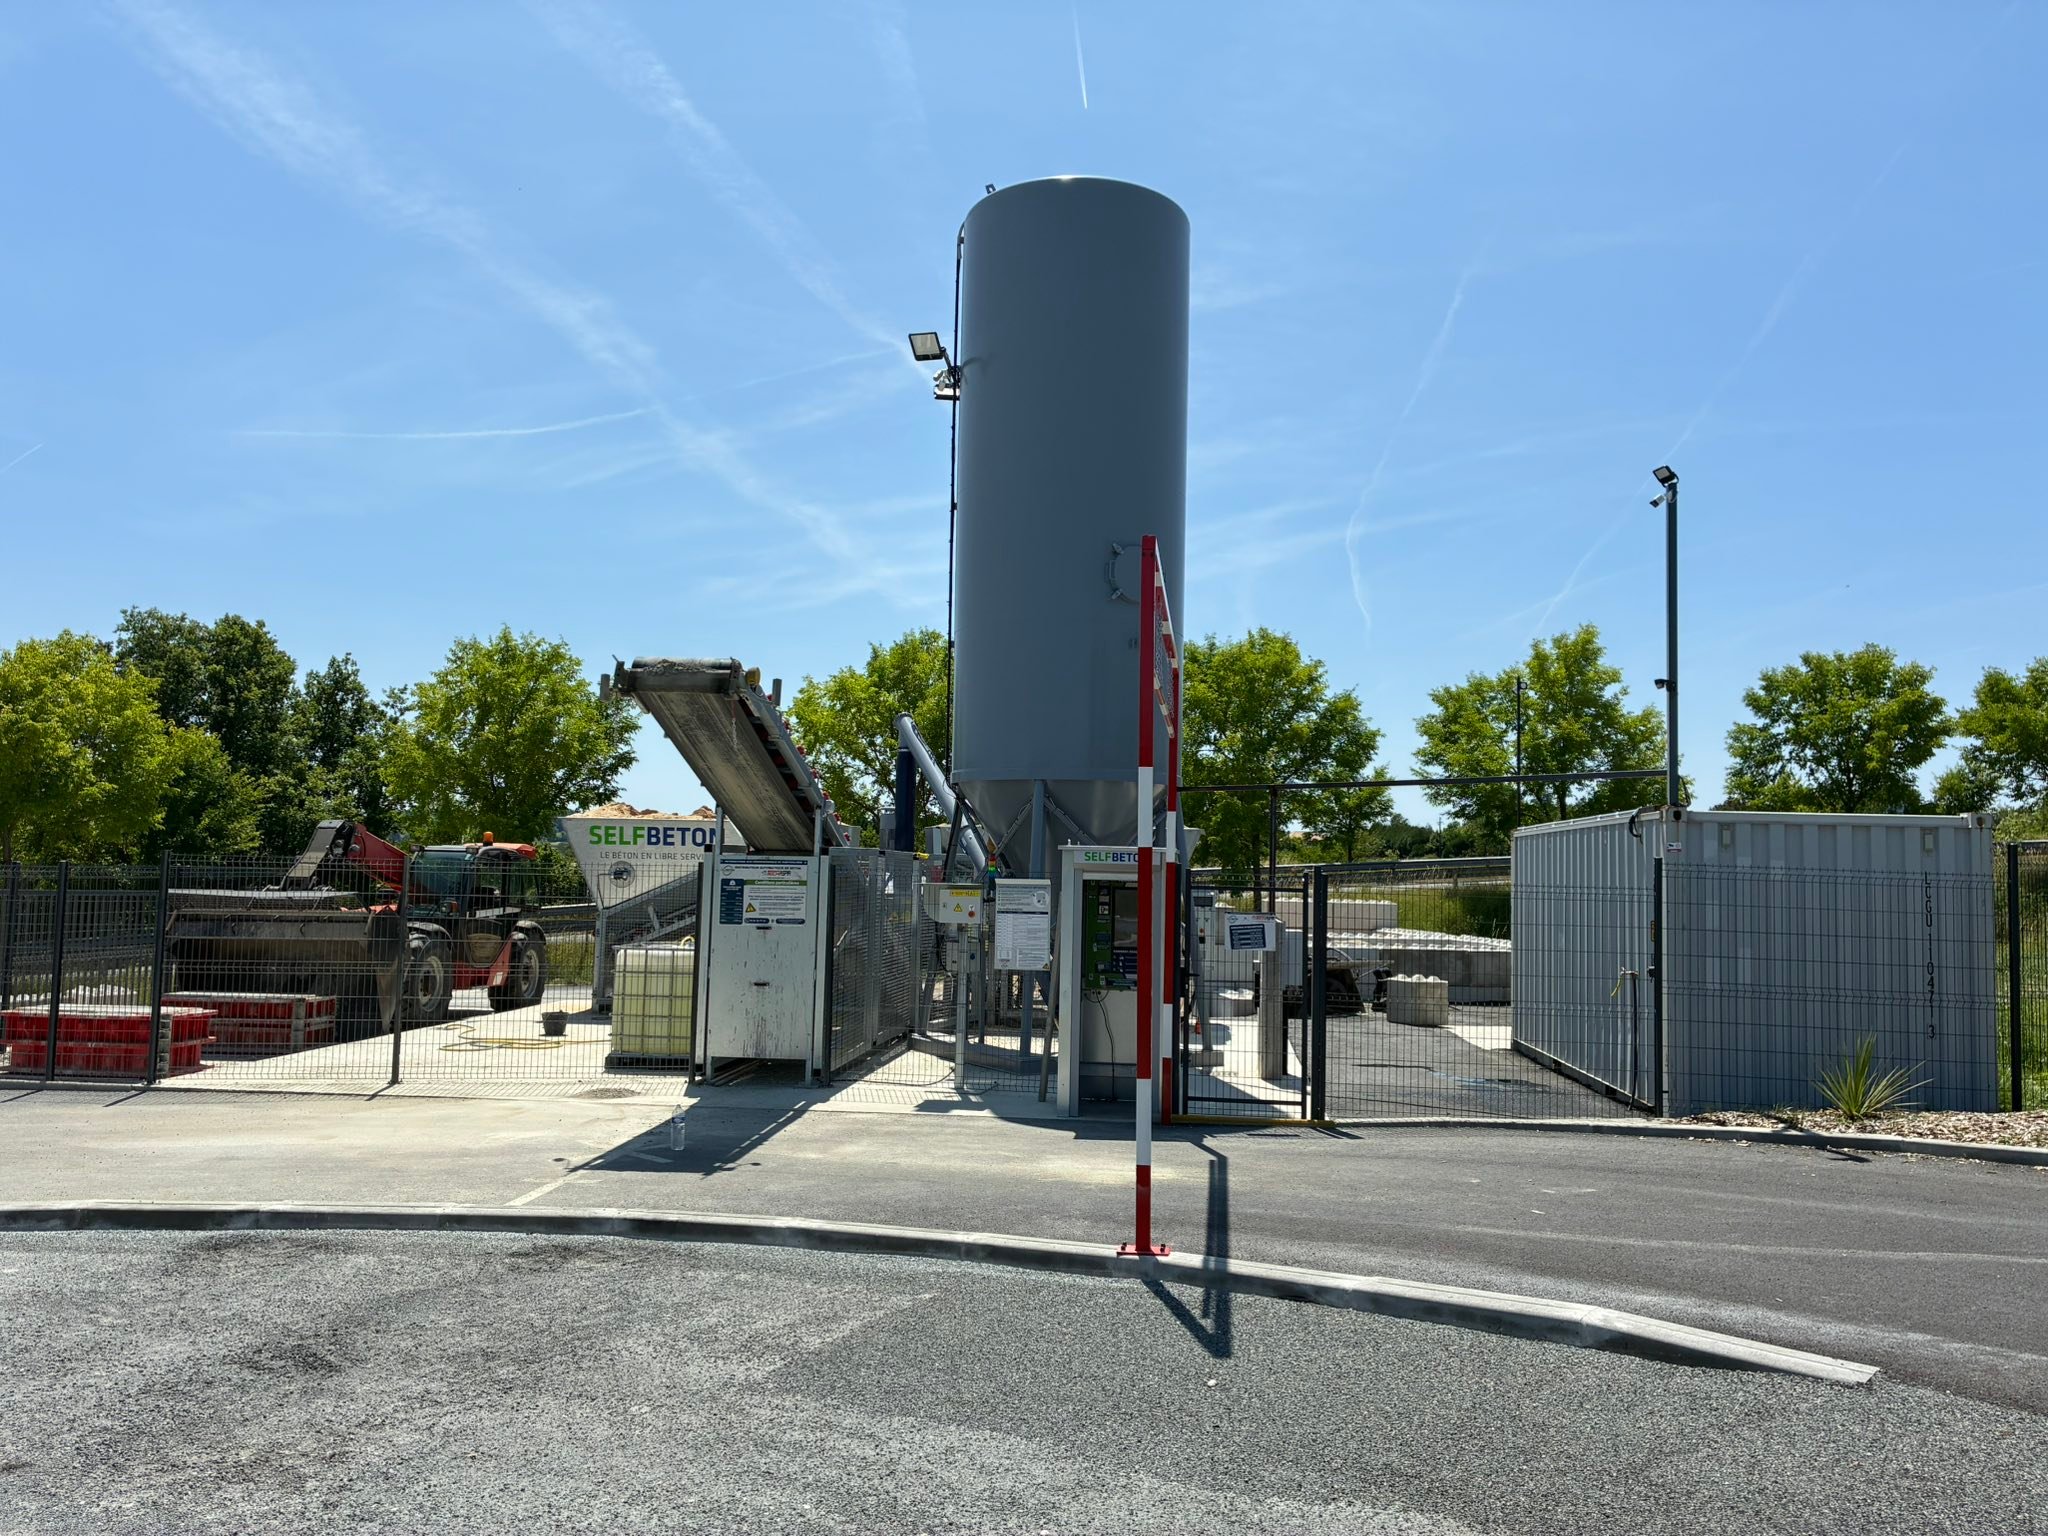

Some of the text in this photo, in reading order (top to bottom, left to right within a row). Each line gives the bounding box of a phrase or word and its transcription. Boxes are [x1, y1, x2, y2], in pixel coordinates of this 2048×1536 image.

[600, 851, 610, 859] LE
[612, 850, 639, 859] BÉTON
[641, 852, 652, 860] EN
[680, 853, 704, 861] SERVI
